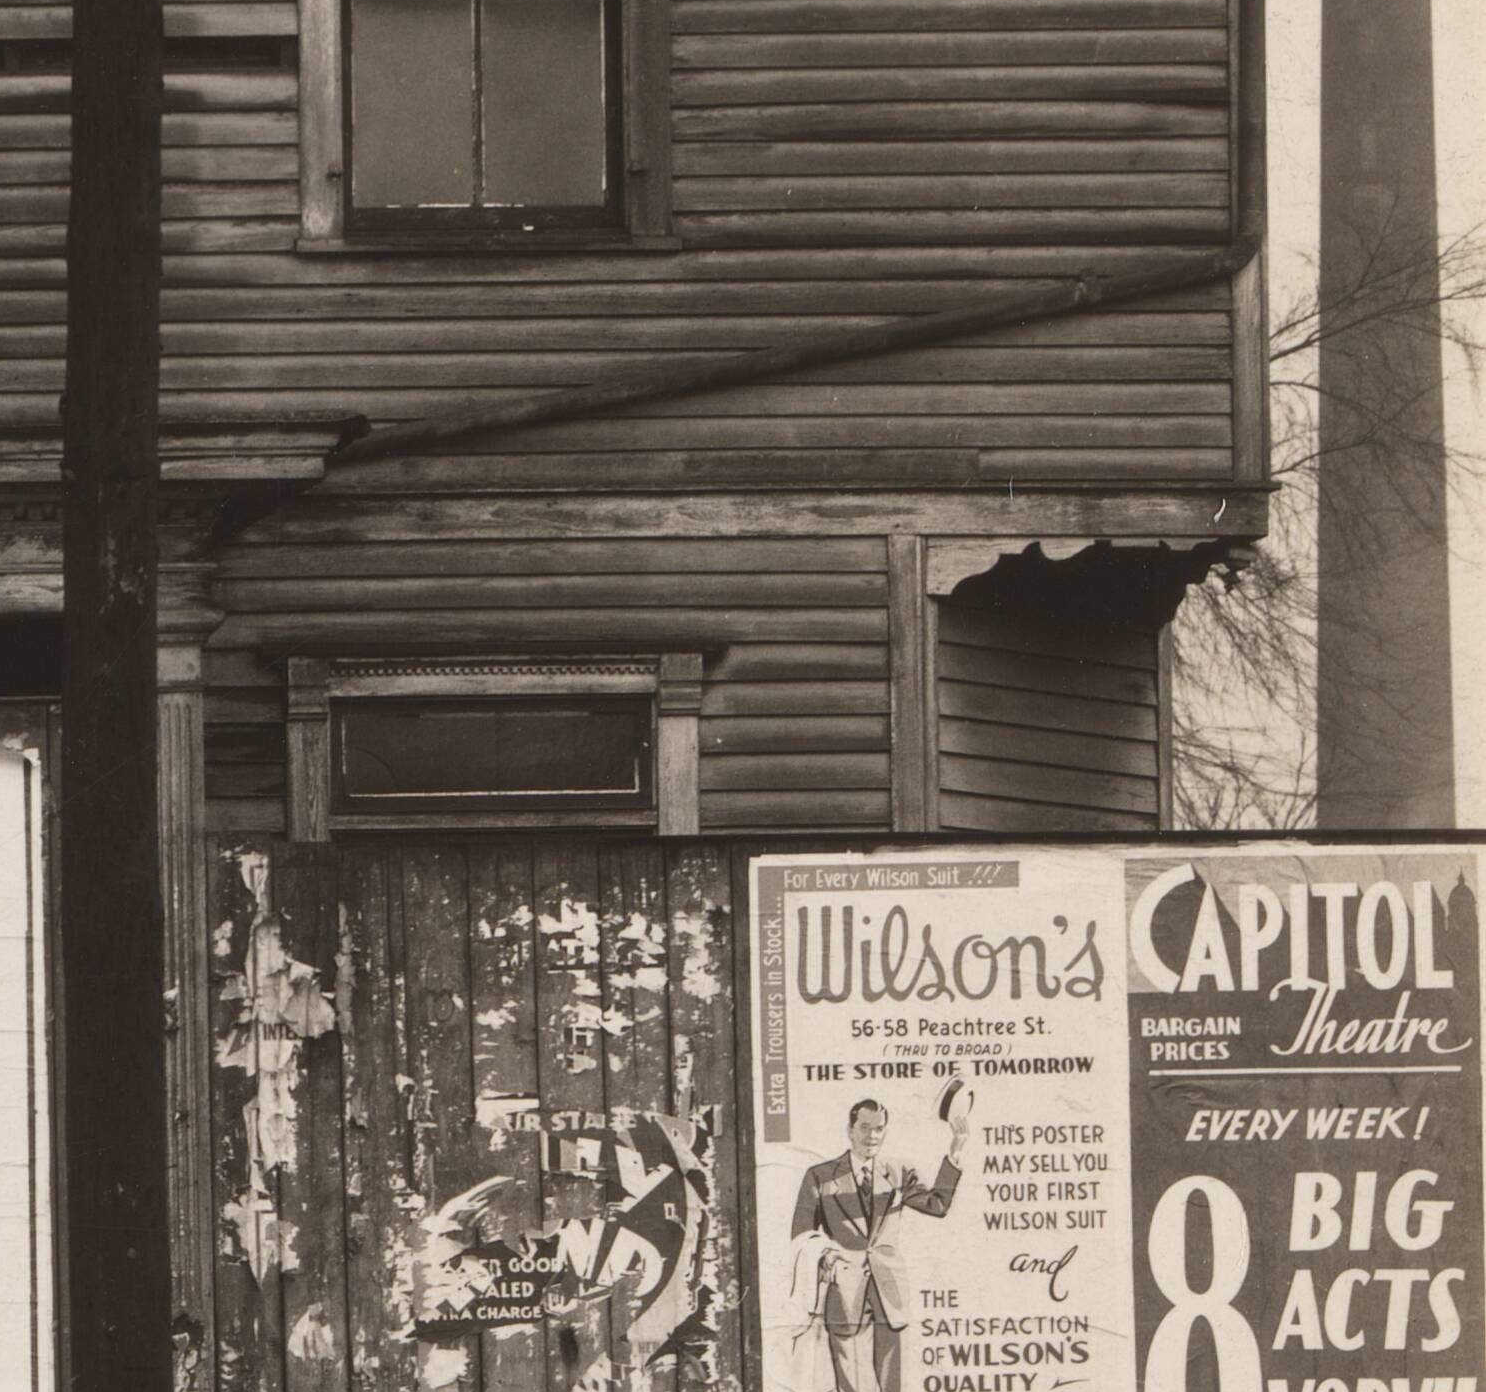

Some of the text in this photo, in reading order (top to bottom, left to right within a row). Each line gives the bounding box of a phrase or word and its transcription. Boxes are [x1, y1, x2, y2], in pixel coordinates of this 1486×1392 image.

[784, 870, 807, 888] For
[816, 870, 859, 889] Every
[866, 868, 919, 886] Wilson
[927, 866, 960, 885] Suit
[1130, 863, 1454, 994] CAPITOL
[798, 905, 1105, 1004] Wilson's
[765, 971, 783, 986] in
[766, 993, 785, 1063] Trousers
[919, 1018, 1015, 1036] Peachtree
[1023, 1017, 1052, 1035] St.
[1141, 1017, 1241, 1036] BARGAIN
[1269, 978, 1472, 1055] Theatre
[934, 1043, 951, 1056] TO
[1151, 1041, 1230, 1060] PRICES
[804, 1057, 1094, 1081] THE STORE OF TOMORROW
[768, 1073, 787, 1115] Extra
[983, 1125, 1104, 1146] THIS POSTER
[1185, 1109, 1299, 1141] EVERY
[983, 1153, 1108, 1174] MAY SELL YOU
[986, 1182, 1101, 1202] YOUR FIRST
[984, 1210, 1107, 1231] WILSON SUIT
[1289, 1169, 1454, 1251] BIG
[1009, 1245, 1078, 1302] and
[920, 1290, 959, 1309] THE
[1272, 1268, 1465, 1352] ACTS
[921, 1316, 1088, 1337] SATISFACTION
[922, 1336, 1089, 1367] OF WILSON'S
